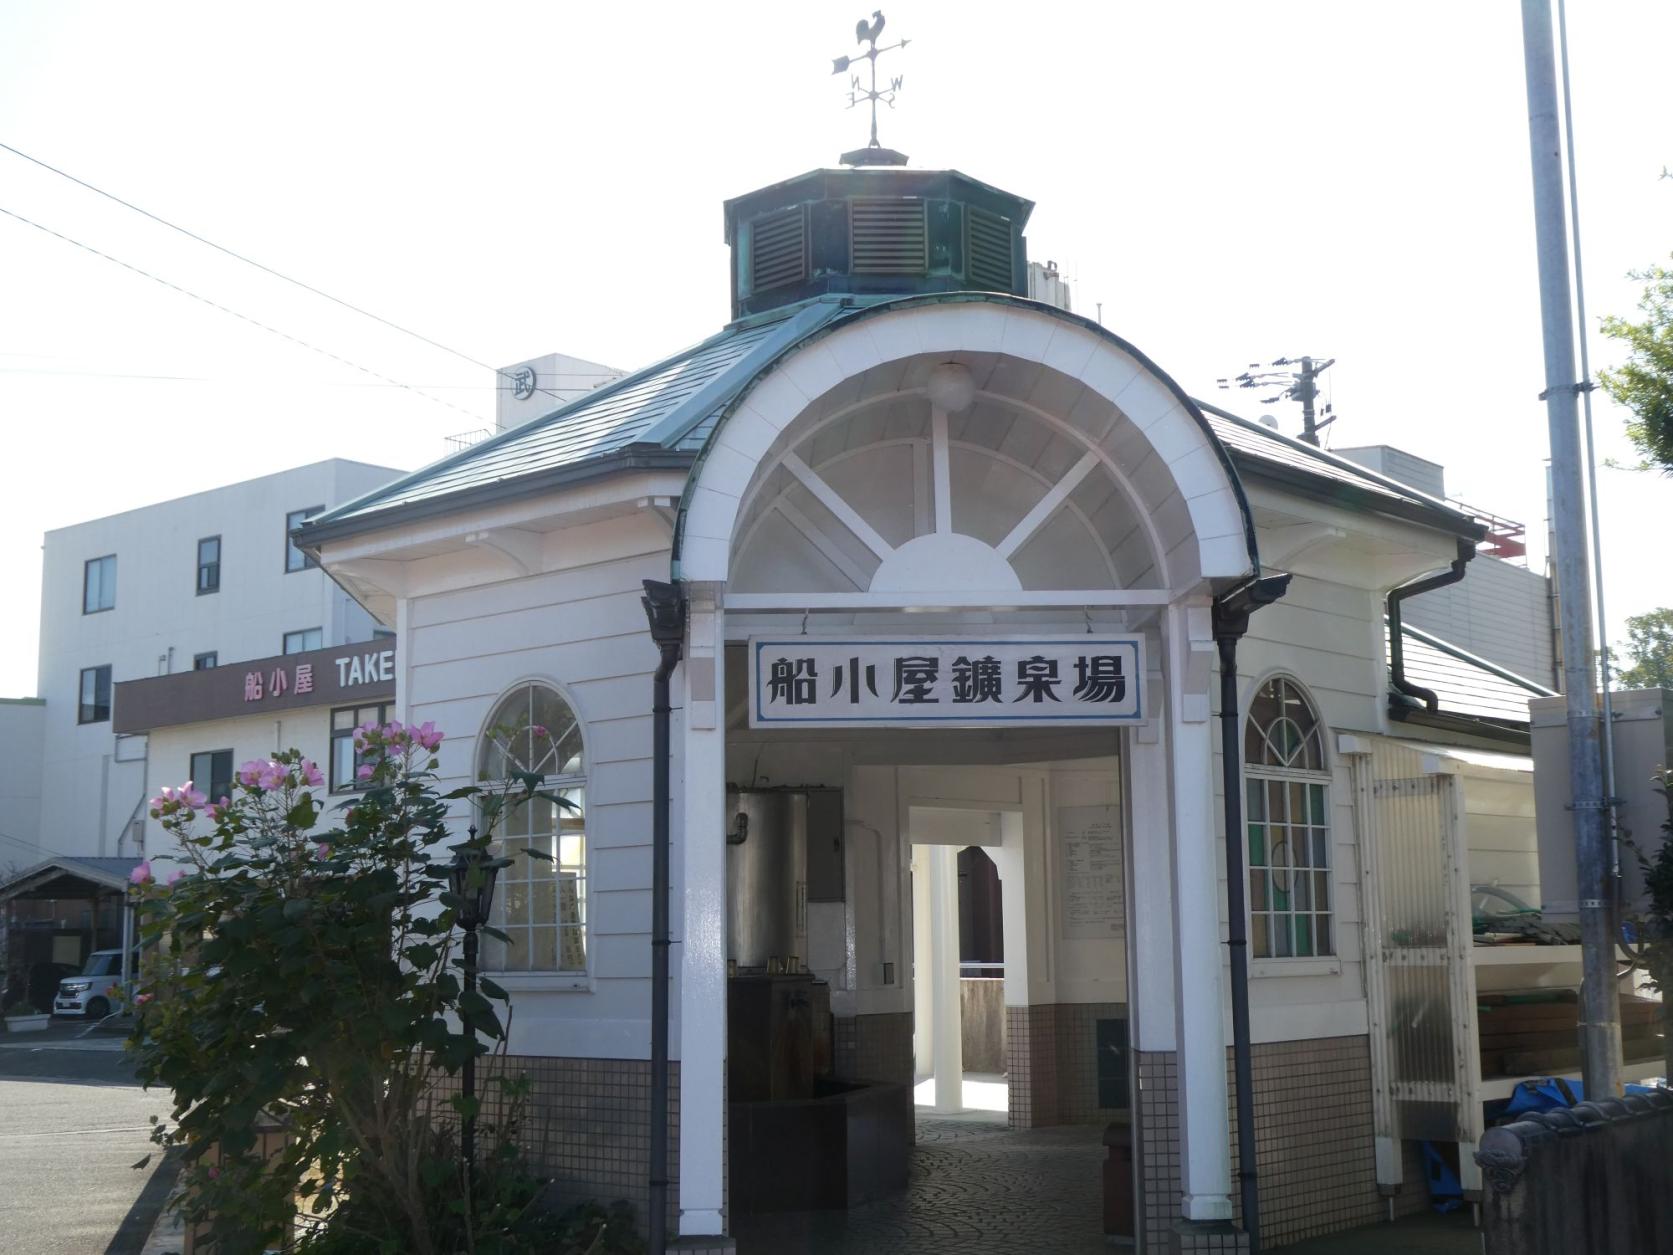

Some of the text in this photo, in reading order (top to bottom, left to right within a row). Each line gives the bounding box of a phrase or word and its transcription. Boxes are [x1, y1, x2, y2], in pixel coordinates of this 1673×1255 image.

[890, 74, 904, 92] W
[244, 650, 397, 702] 船小屋 TAKE
